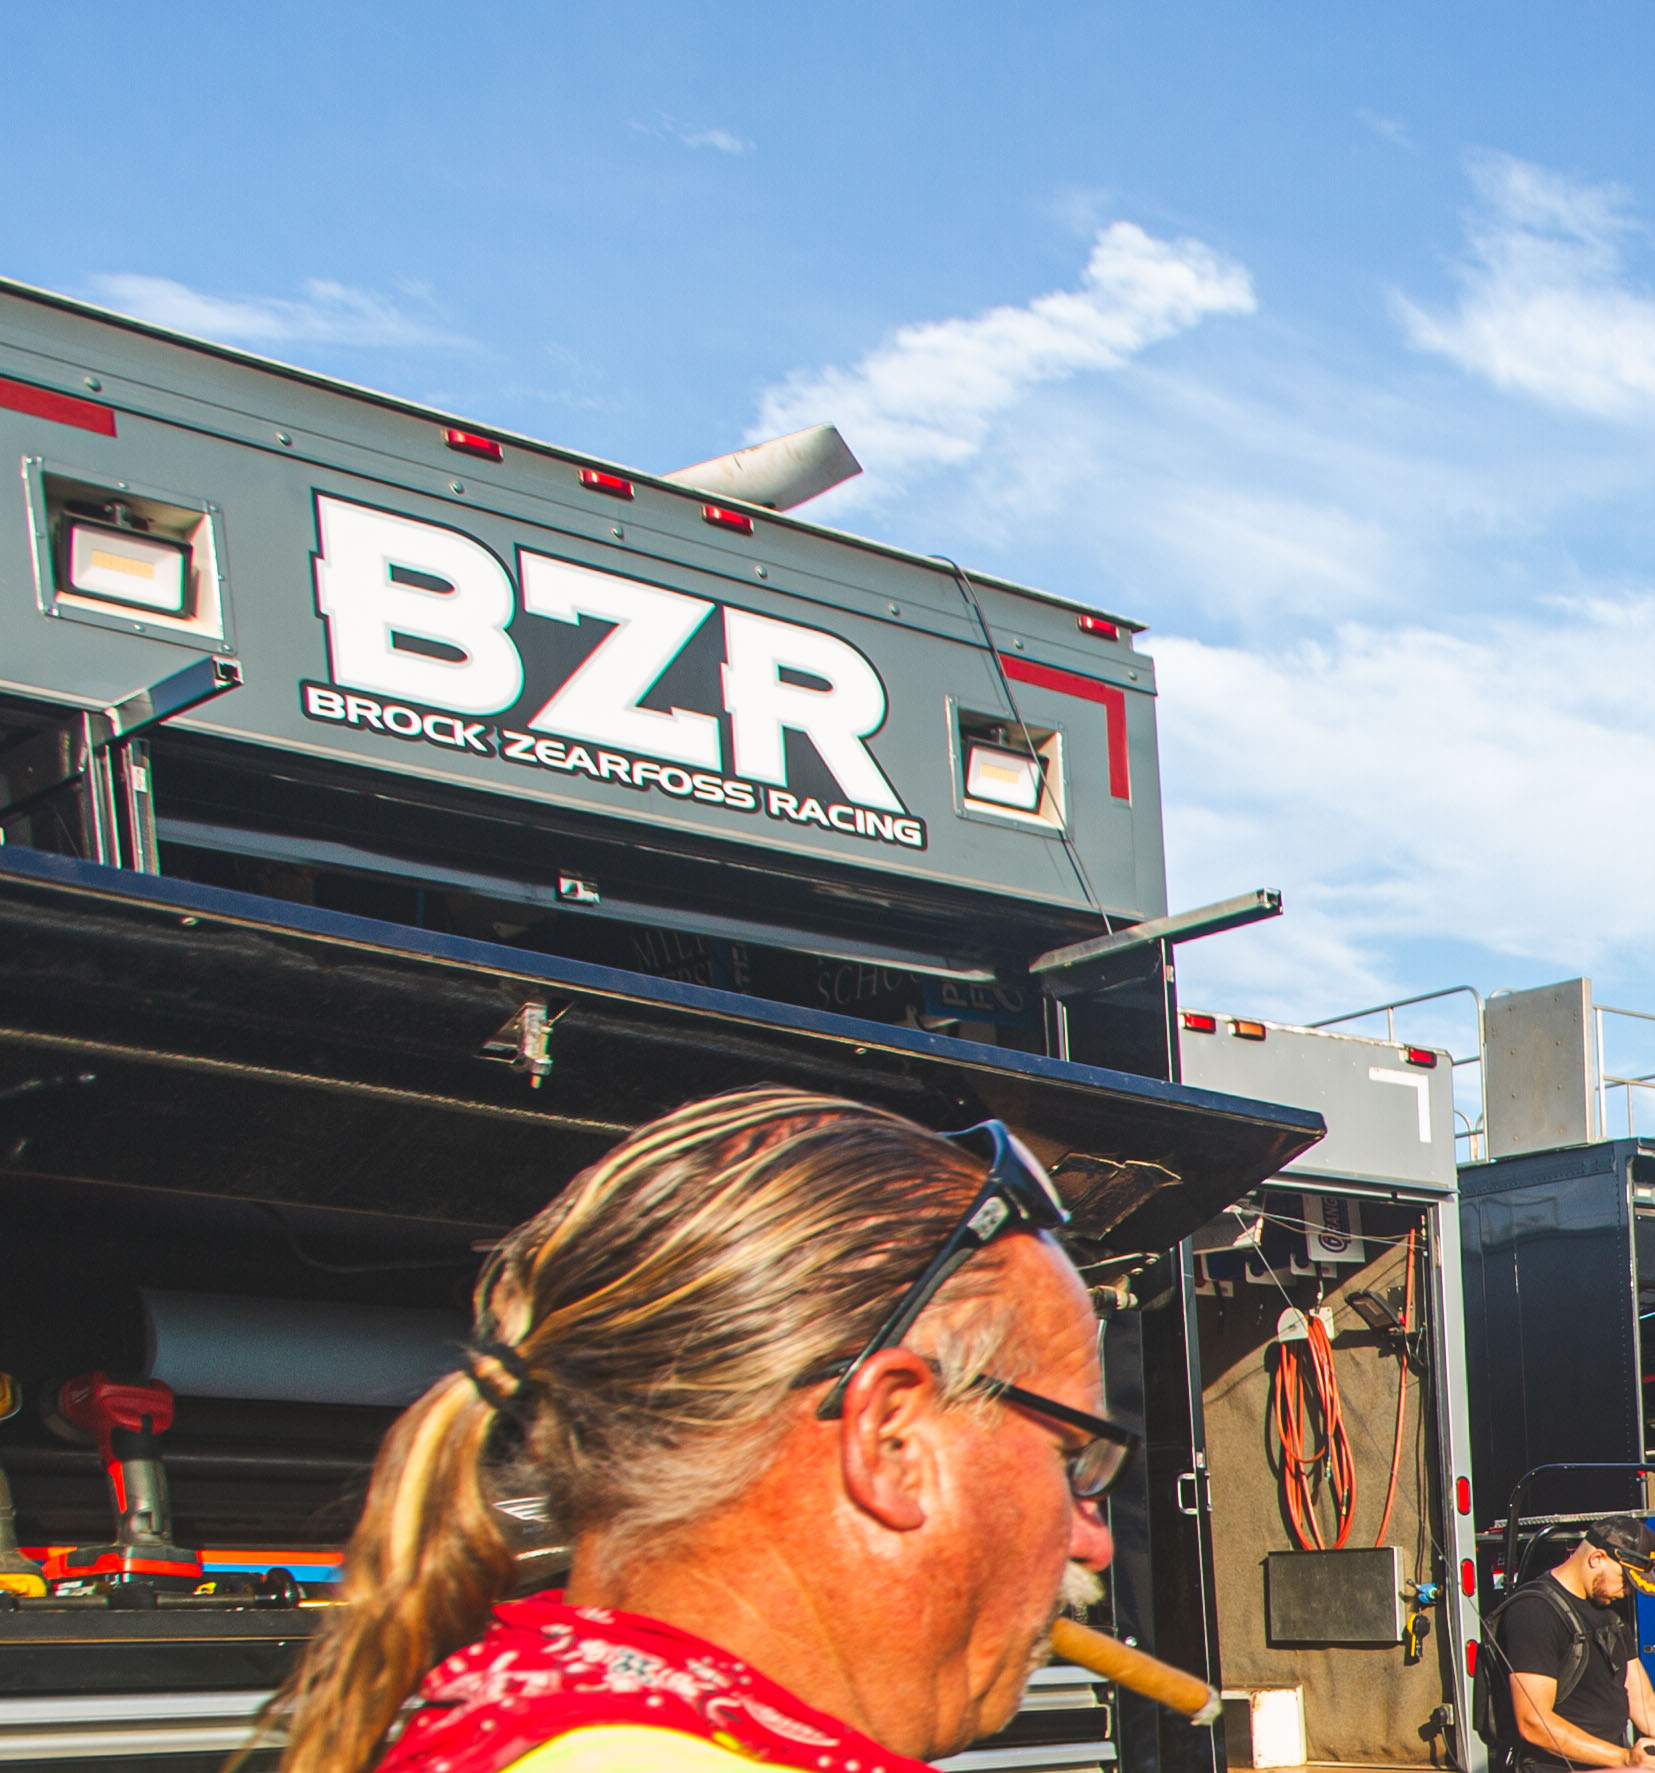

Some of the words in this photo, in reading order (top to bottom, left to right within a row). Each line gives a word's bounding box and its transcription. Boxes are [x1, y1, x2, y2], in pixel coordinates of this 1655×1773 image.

[305, 683, 486, 751] BROCK
[500, 728, 757, 810] ZEARFOSS
[768, 789, 924, 847] RACING
[315, 490, 908, 814] BZR
